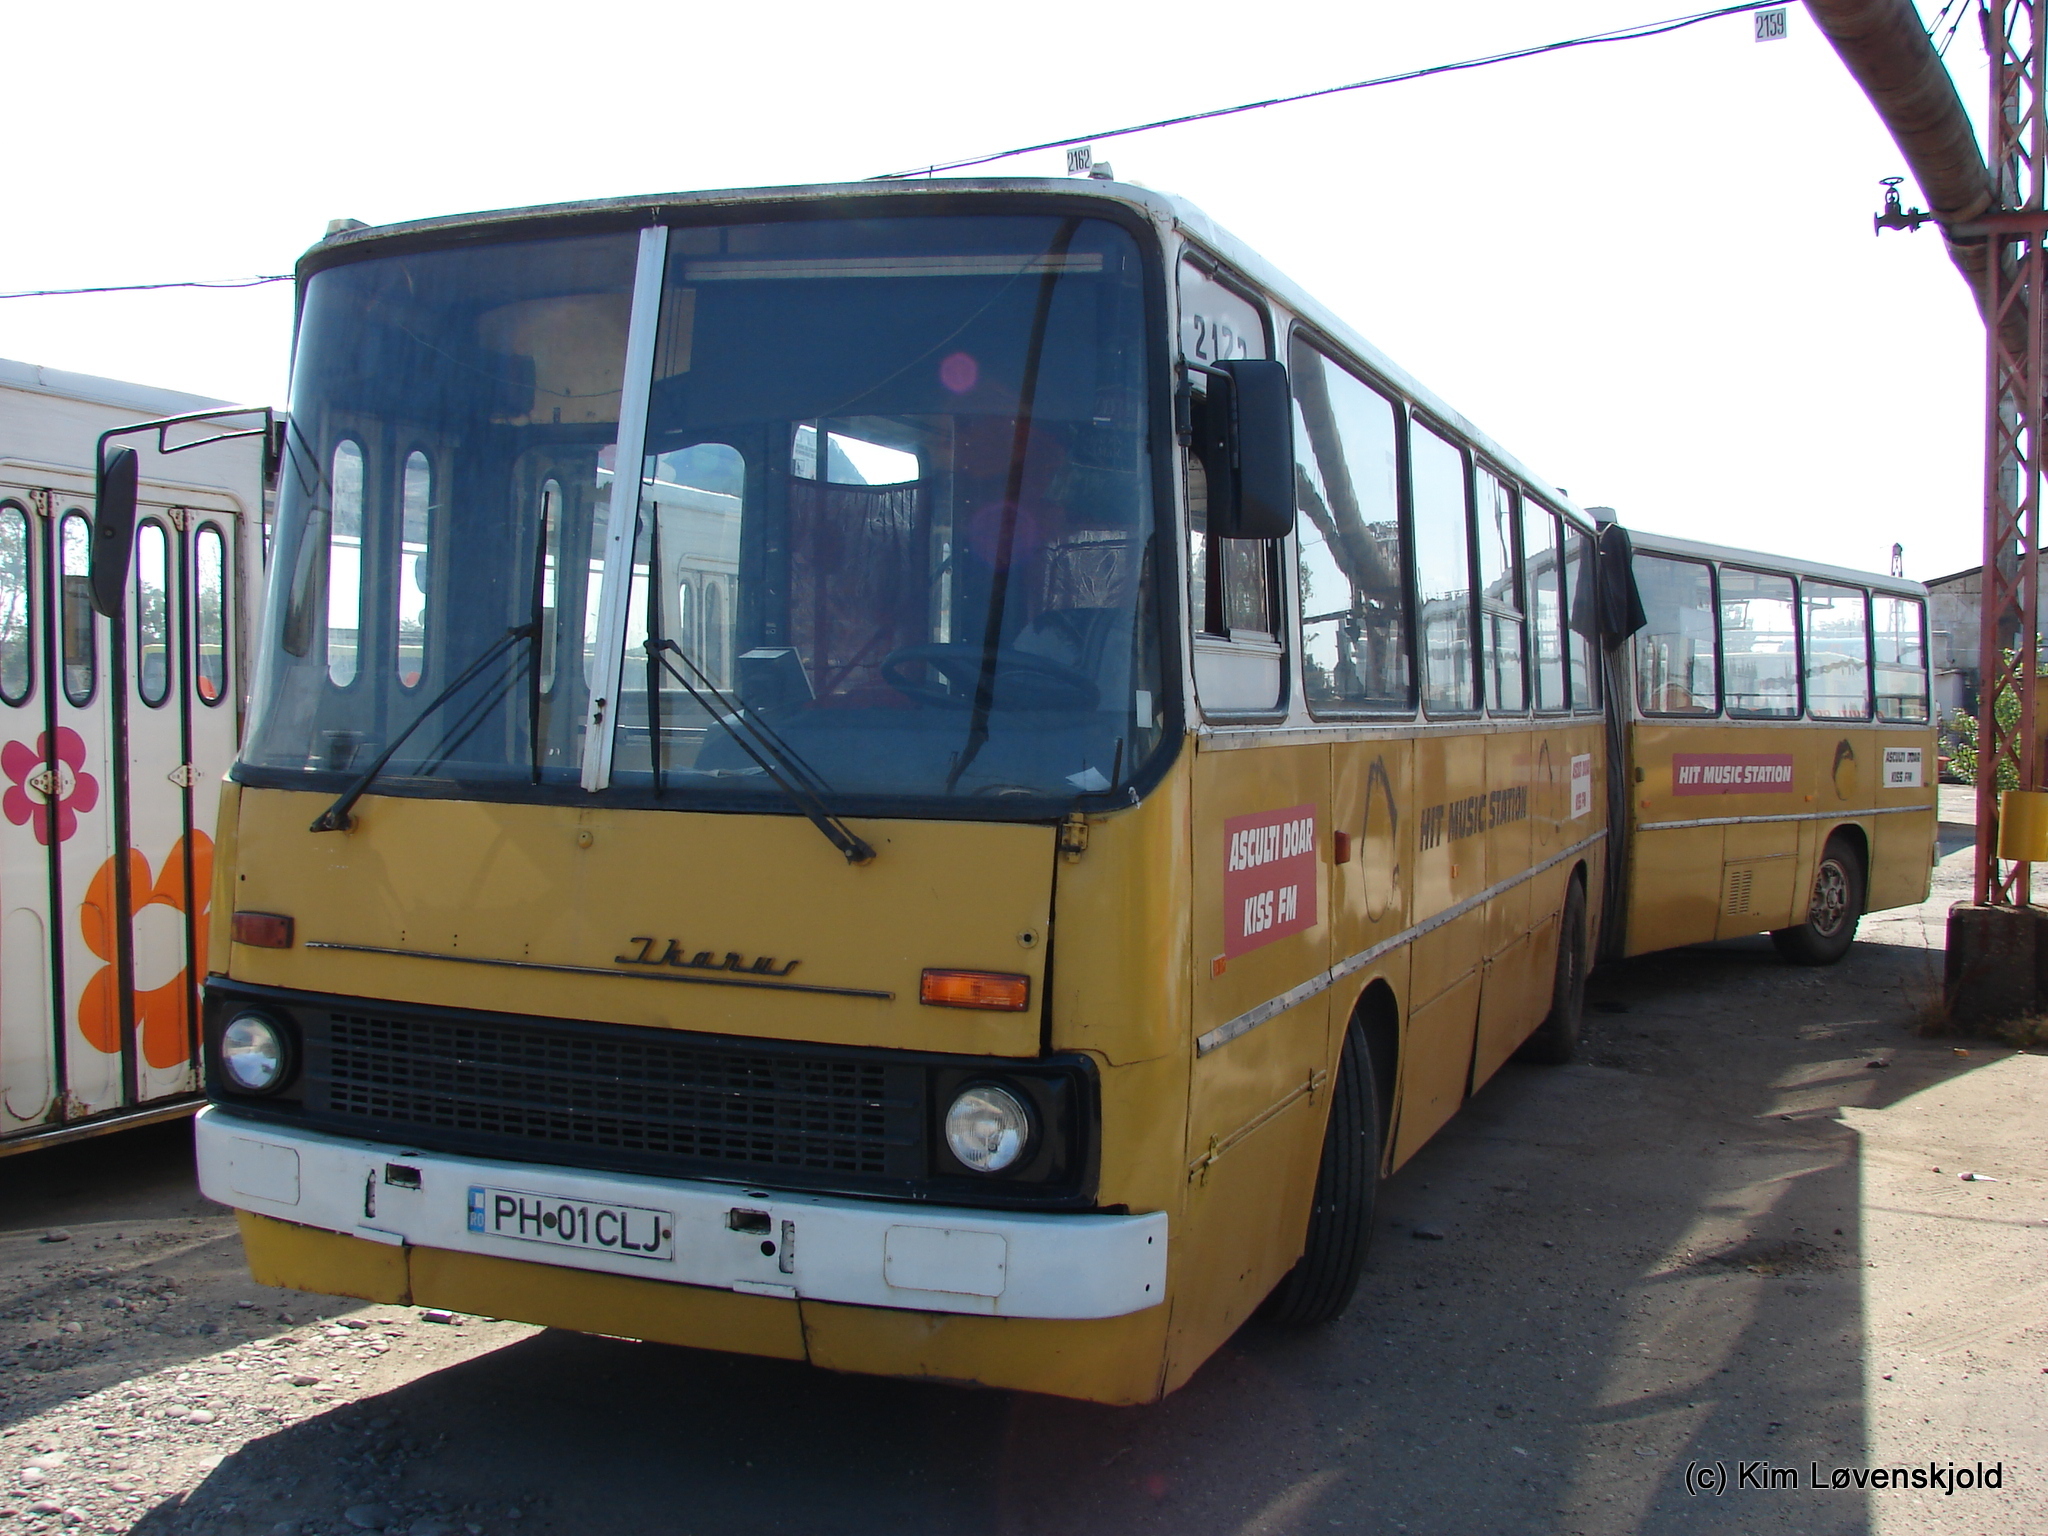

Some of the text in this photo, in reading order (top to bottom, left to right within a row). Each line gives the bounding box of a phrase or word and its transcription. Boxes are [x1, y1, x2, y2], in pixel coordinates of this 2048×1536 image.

[1756, 12, 1784, 39] 2159
[1067, 148, 1090, 172] 2162
[1679, 765, 1792, 784] HIT MUSIC STATION
[1420, 785, 1528, 852] HIT MUSIC STATION
[1228, 817, 1314, 872] ASCULTI DOAR
[1243, 884, 1298, 937] KISS FM
[614, 936, 802, 977] Ikarus
[470, 1212, 485, 1227] RO
